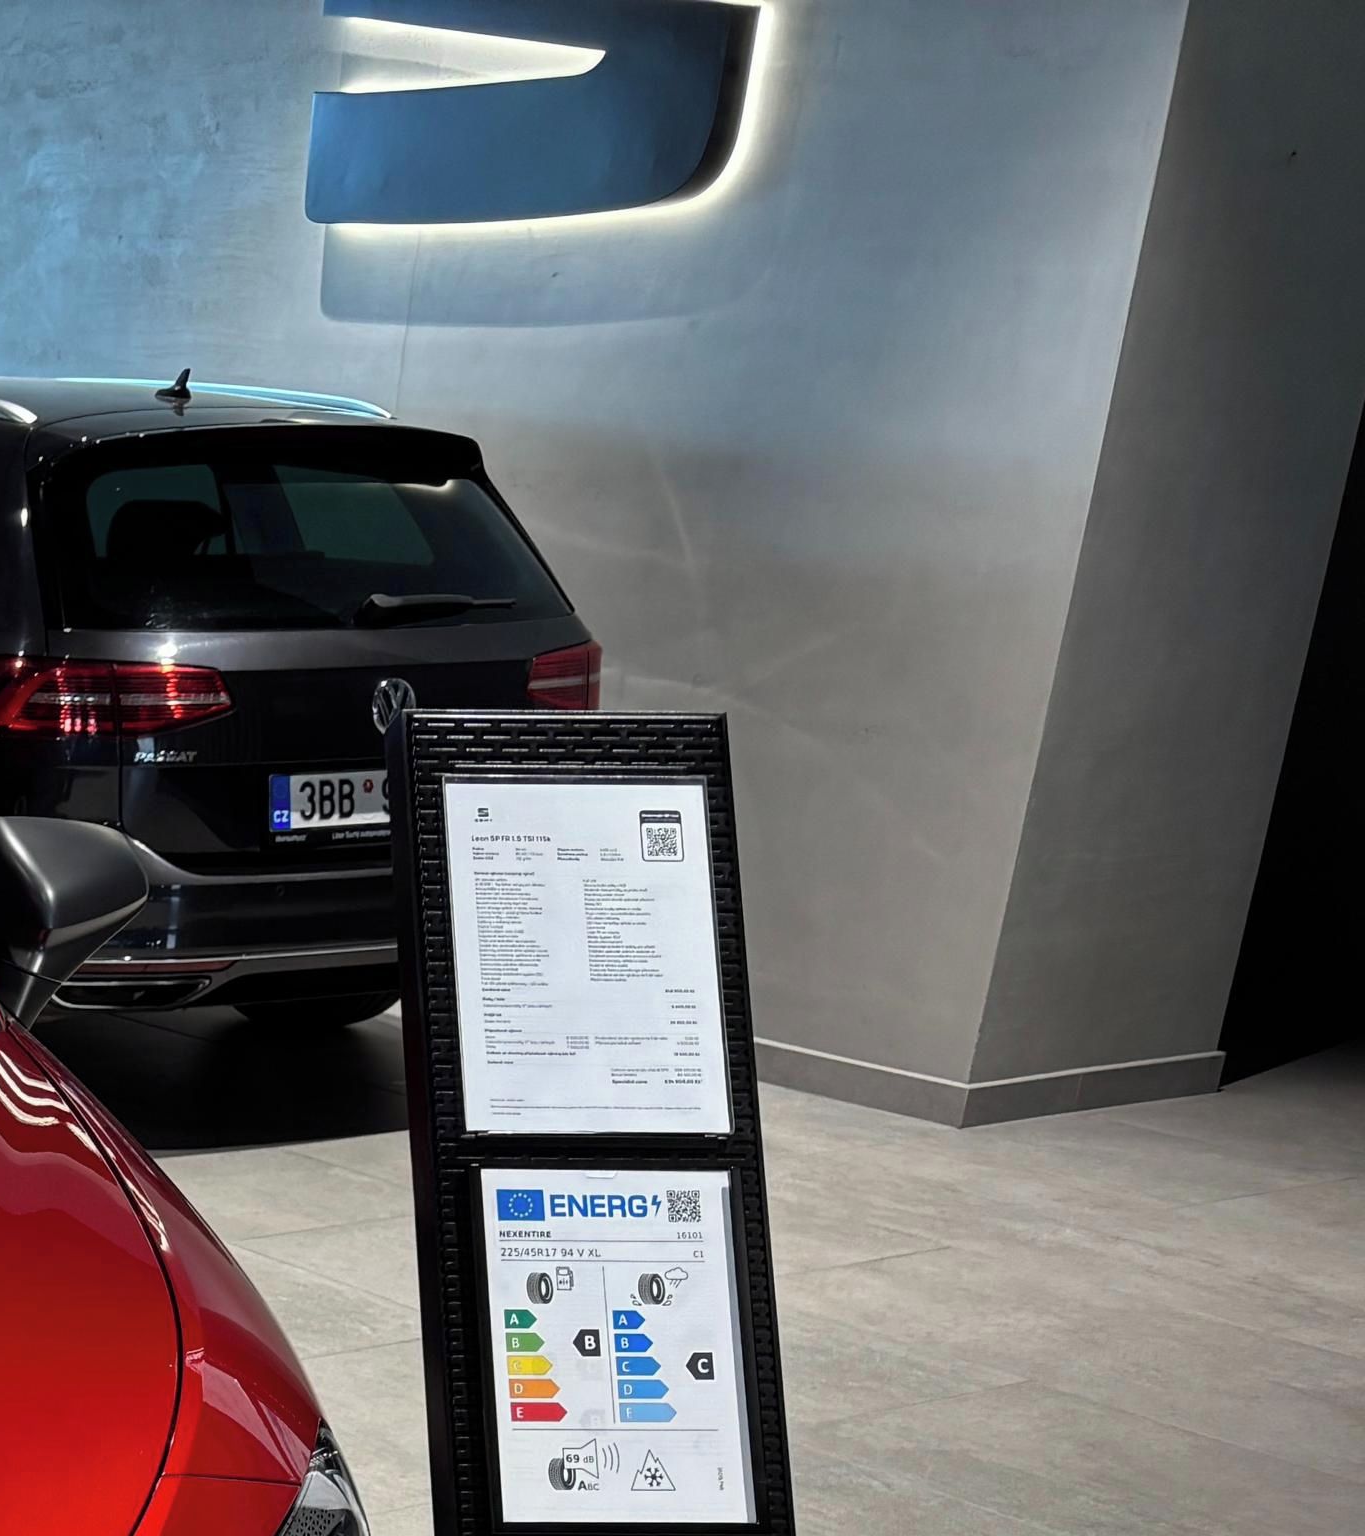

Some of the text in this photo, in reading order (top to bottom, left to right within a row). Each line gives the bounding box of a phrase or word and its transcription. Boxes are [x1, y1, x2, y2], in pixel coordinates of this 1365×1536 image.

[299, 778, 355, 821] 3BB
[273, 810, 289, 823] CZ
[549, 1194, 648, 1218] ENERG
[499, 1230, 552, 1238] NEXENTIRE
[677, 1232, 703, 1240] 16101
[500, 1247, 601, 1258] 225/45R17 94 V XL
[510, 1313, 519, 1325] A
[618, 1314, 628, 1326] A
[512, 1337, 520, 1348] B
[584, 1335, 597, 1350] B
[621, 1338, 629, 1348] B
[622, 1361, 630, 1372] C
[697, 1358, 710, 1373] C
[514, 1384, 523, 1394] D
[624, 1384, 632, 1395] D
[516, 1407, 524, 1418] E
[566, 1454, 594, 1463] 69 dB
